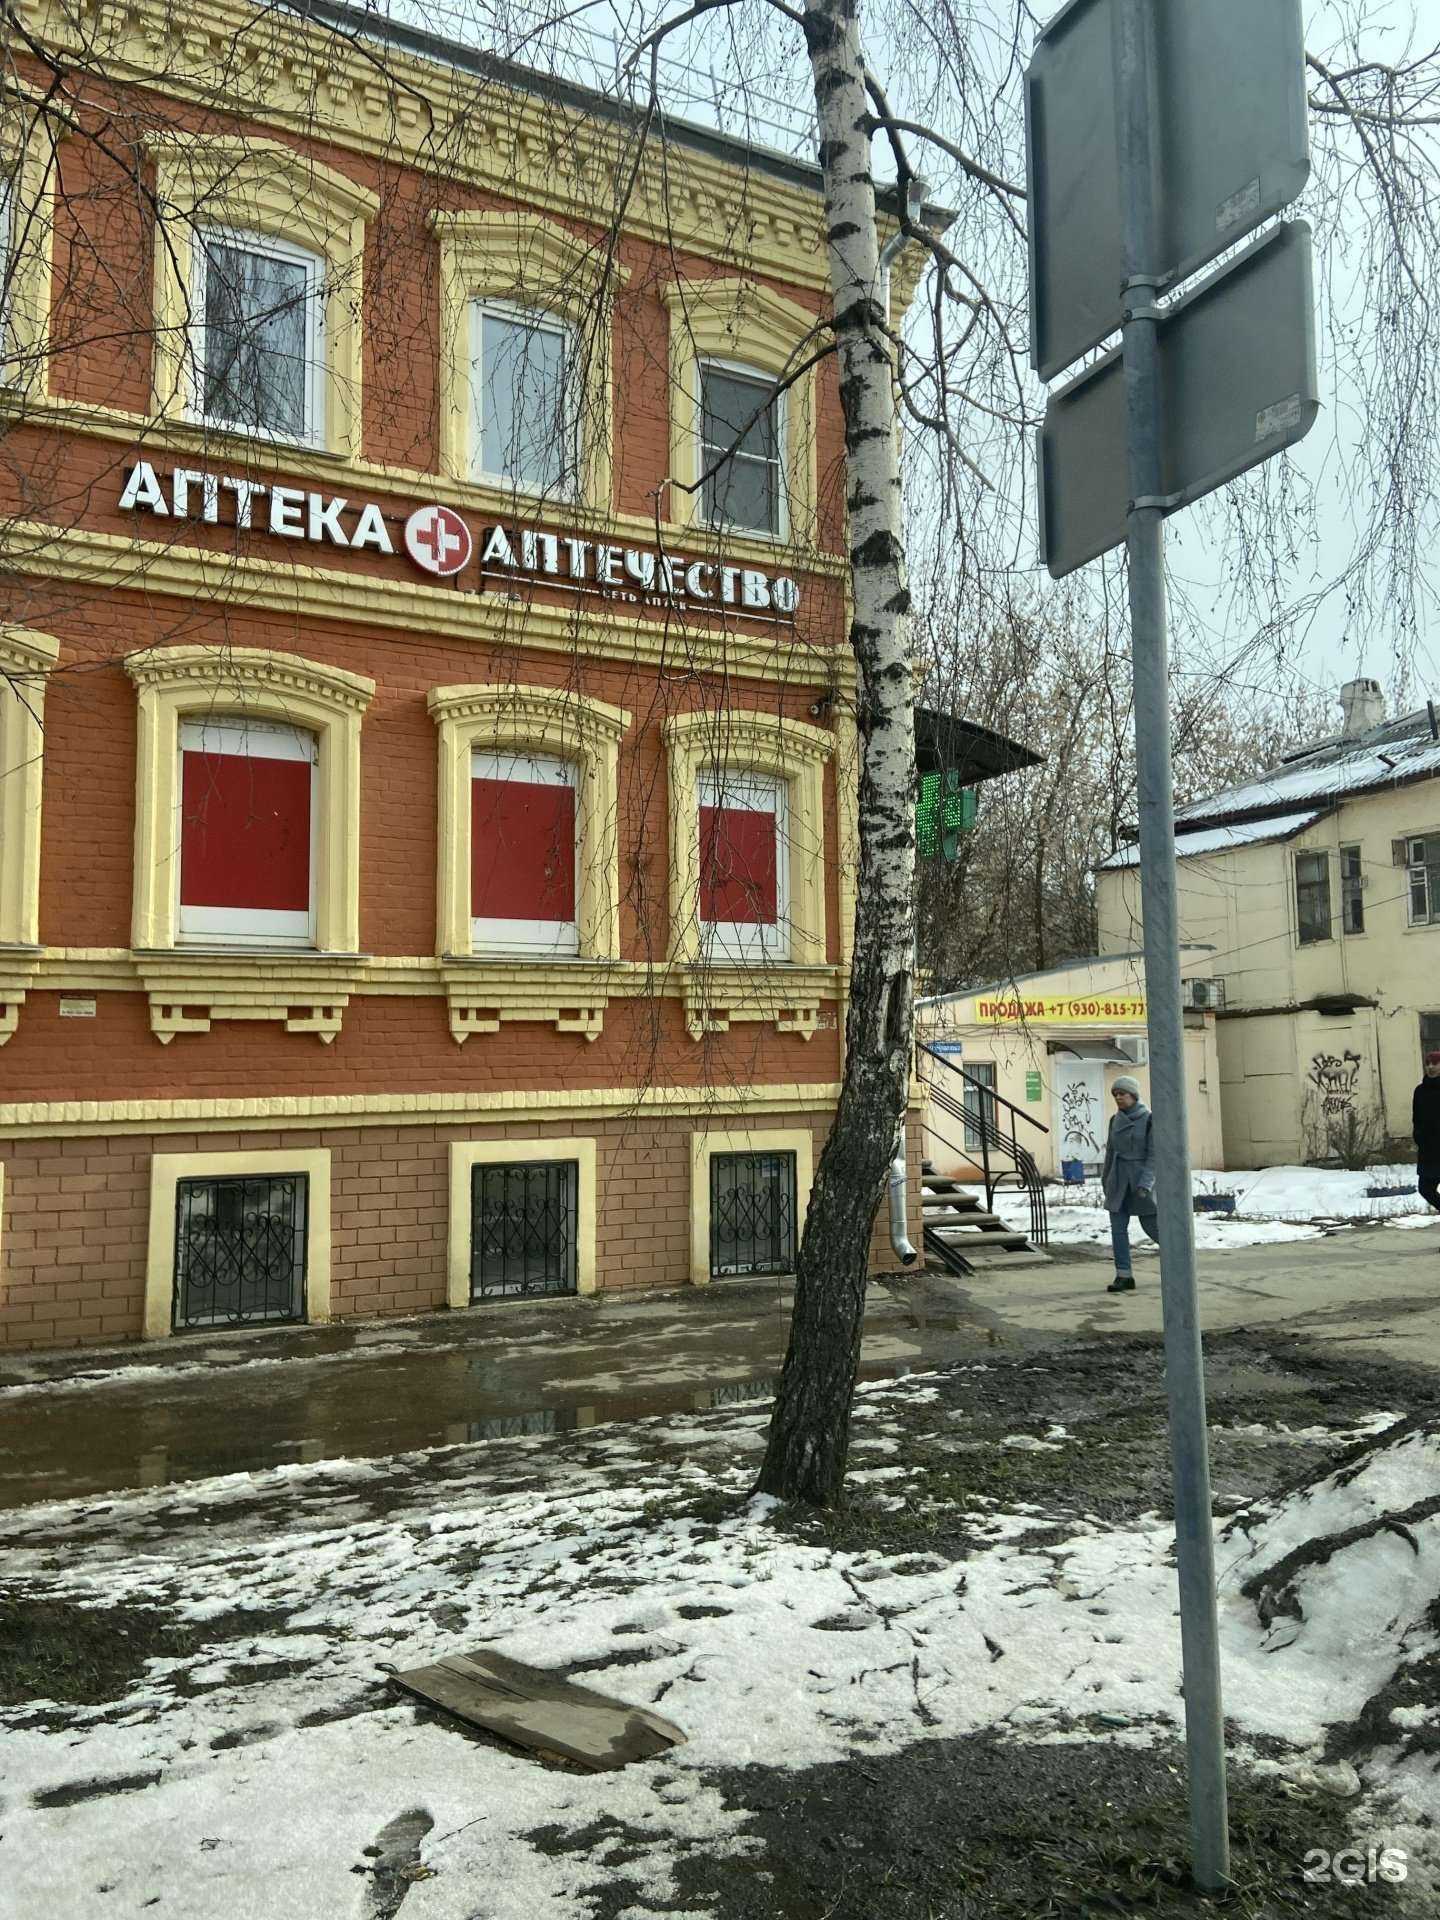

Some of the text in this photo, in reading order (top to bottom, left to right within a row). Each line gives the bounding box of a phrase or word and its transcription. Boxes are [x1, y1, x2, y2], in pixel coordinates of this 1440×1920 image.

[118, 460, 394, 554] АПТЕКА
[481, 523, 800, 612] АПТЕЧЕСТВО
[979, 1001, 1045, 1019] ПРОДАЖА
[1049, 1003, 1064, 1016] +7
